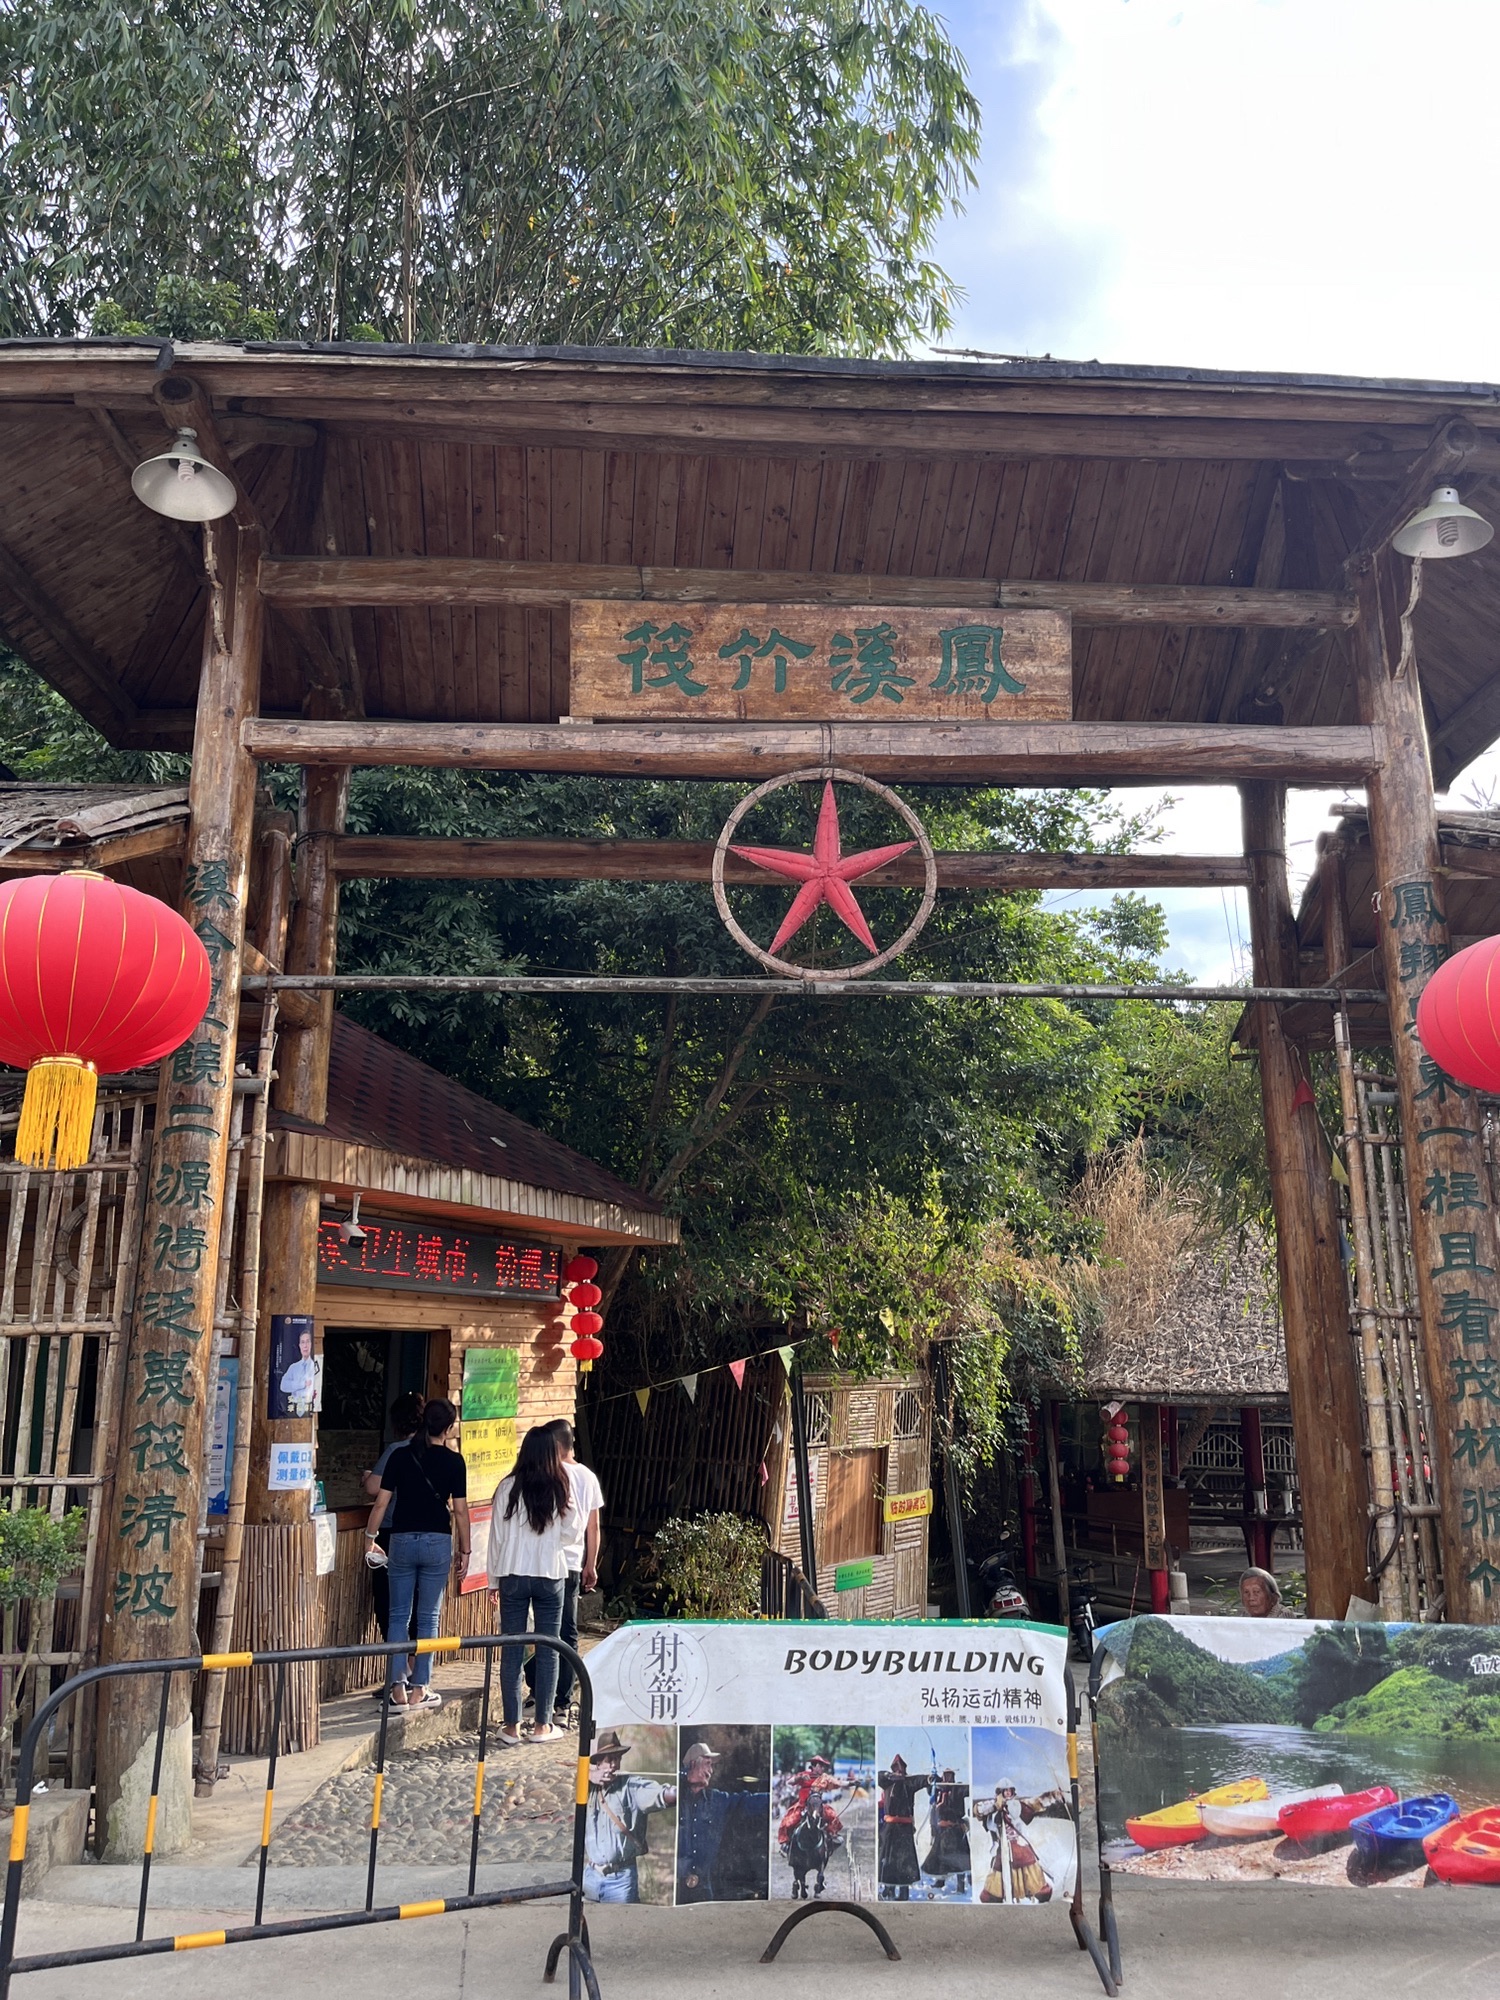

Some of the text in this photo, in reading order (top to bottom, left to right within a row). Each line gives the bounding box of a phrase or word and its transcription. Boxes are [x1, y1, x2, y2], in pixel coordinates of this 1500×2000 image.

[643, 1630, 684, 1720] 射箭
[784, 1649, 1045, 1676] BODYBUILDING
[920, 1686, 1042, 1710] 弘扬运动精神
